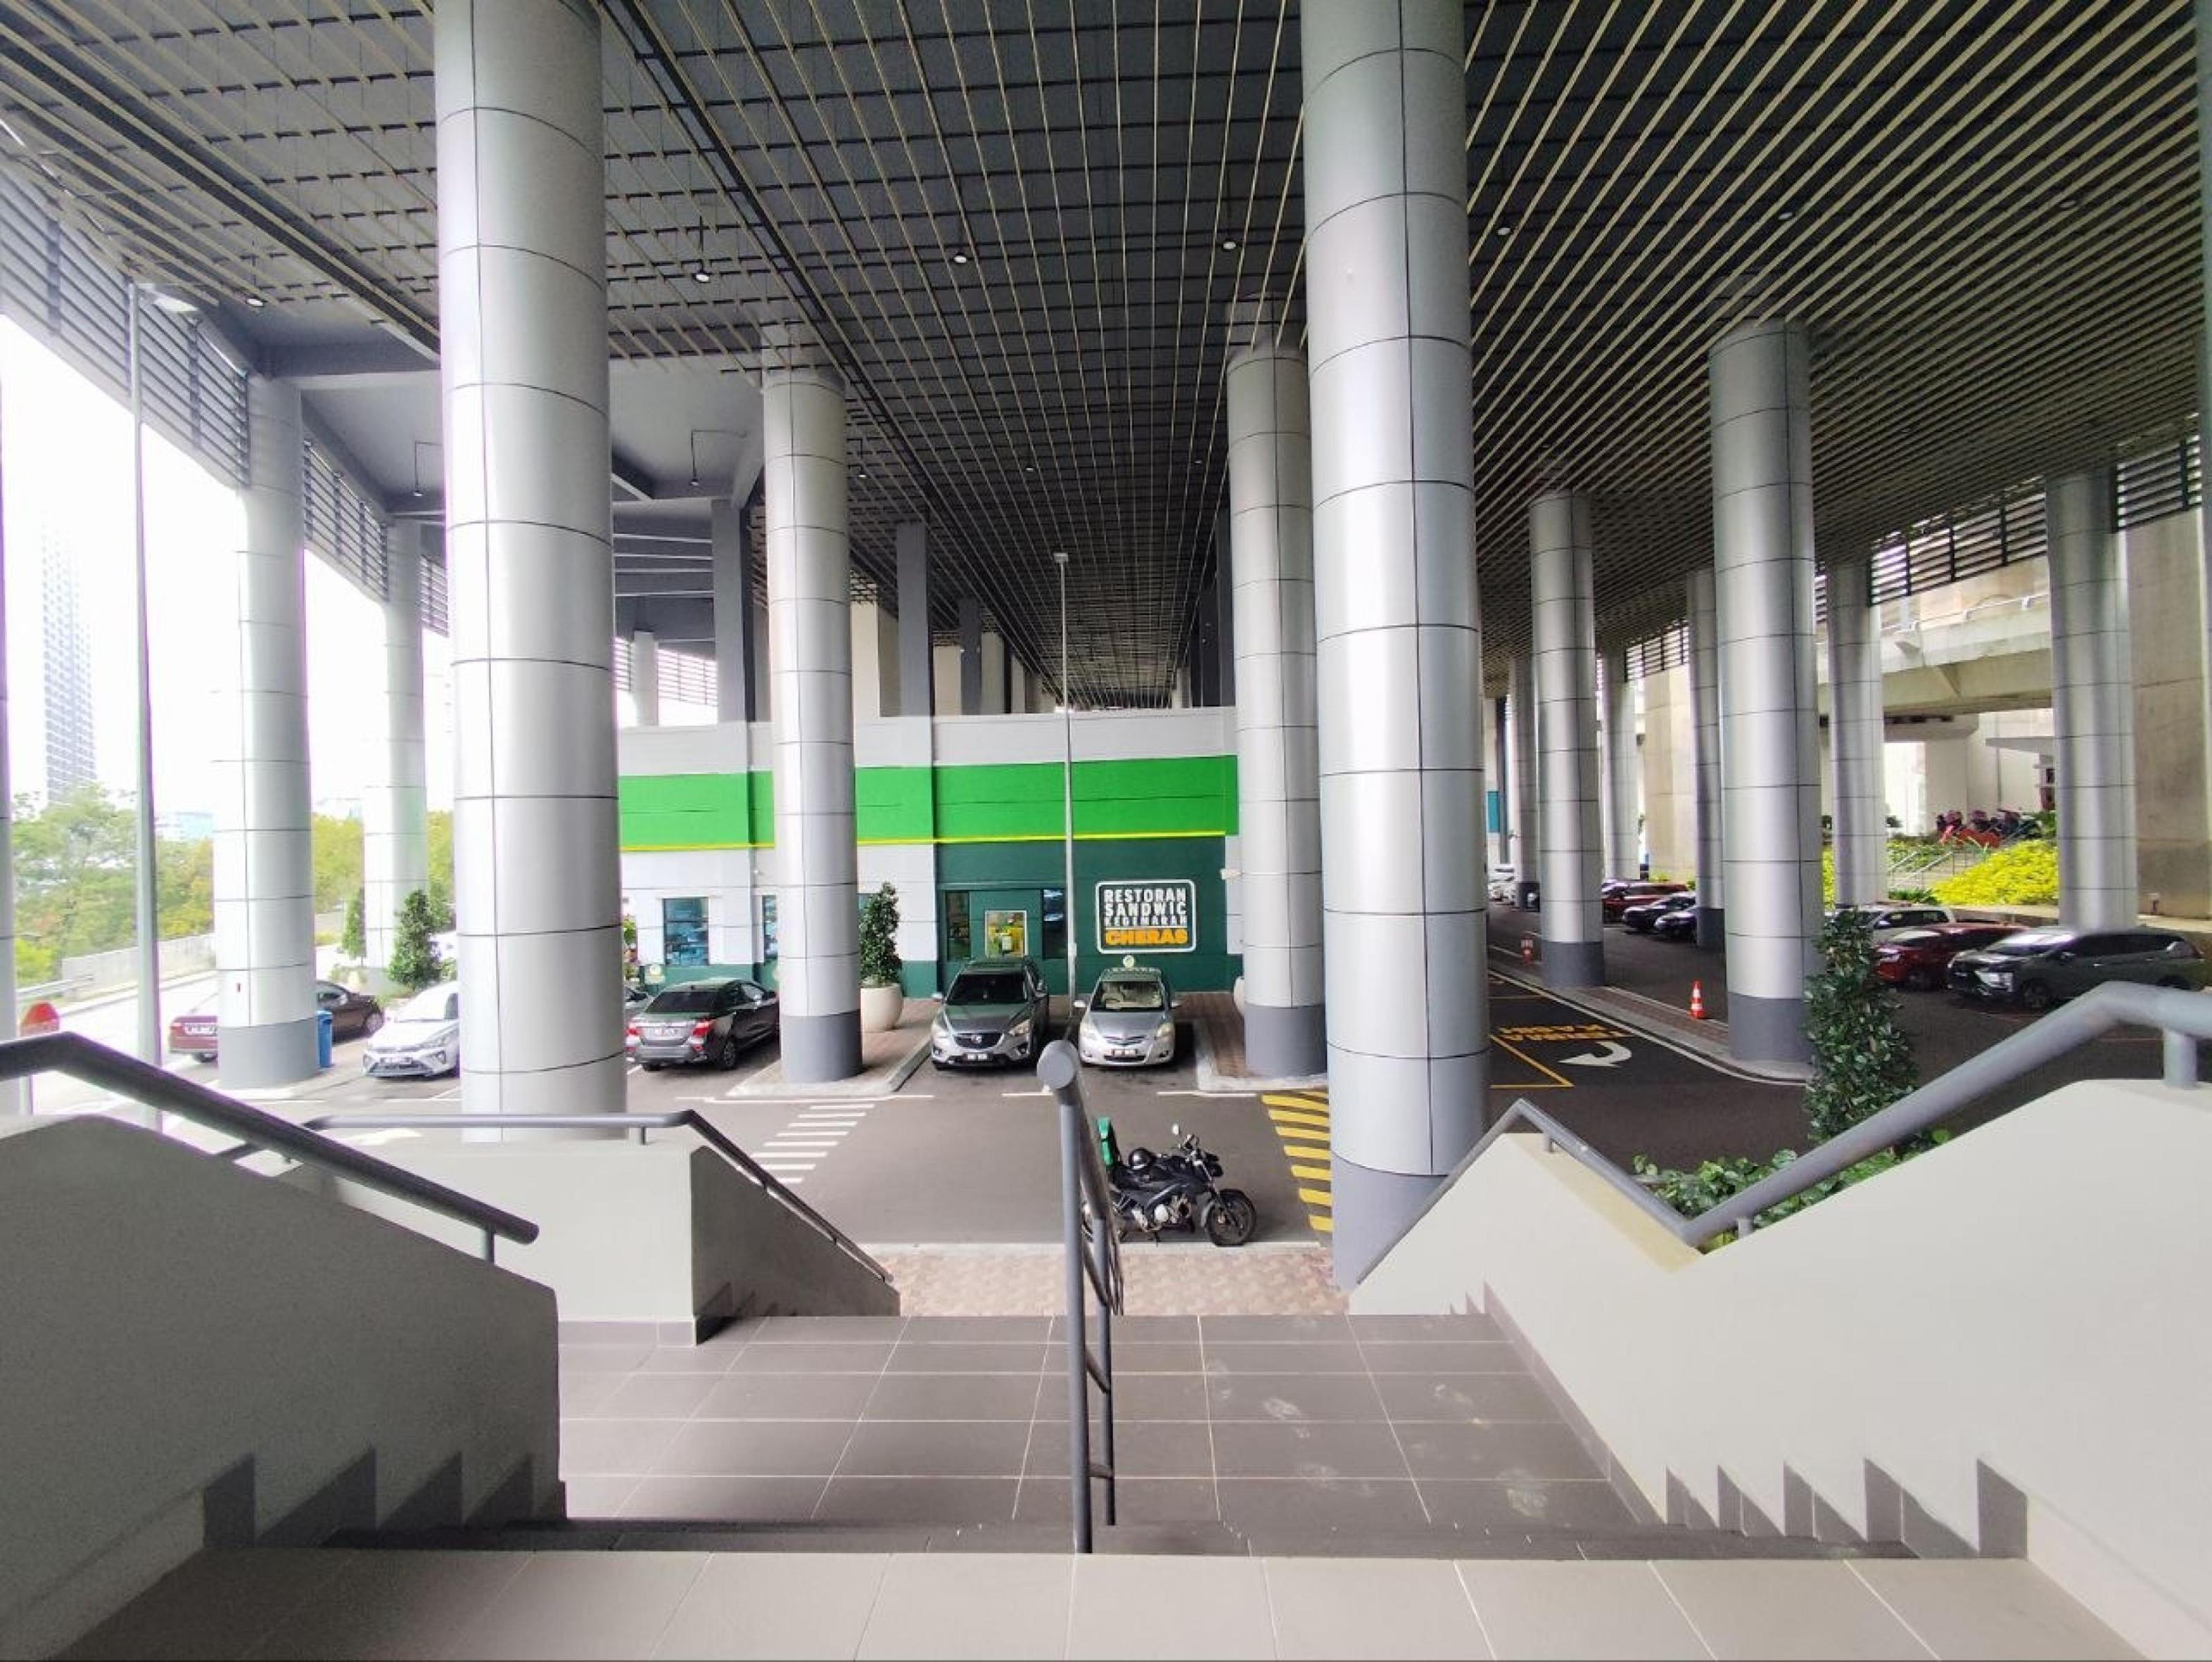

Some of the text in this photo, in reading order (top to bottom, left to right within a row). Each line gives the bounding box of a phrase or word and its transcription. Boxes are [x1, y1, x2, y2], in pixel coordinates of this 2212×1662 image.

[1105, 888, 1186, 902] RESTORAN
[1105, 902, 1186, 915] SANDWIC
[1105, 929, 1188, 945] CHERAS
